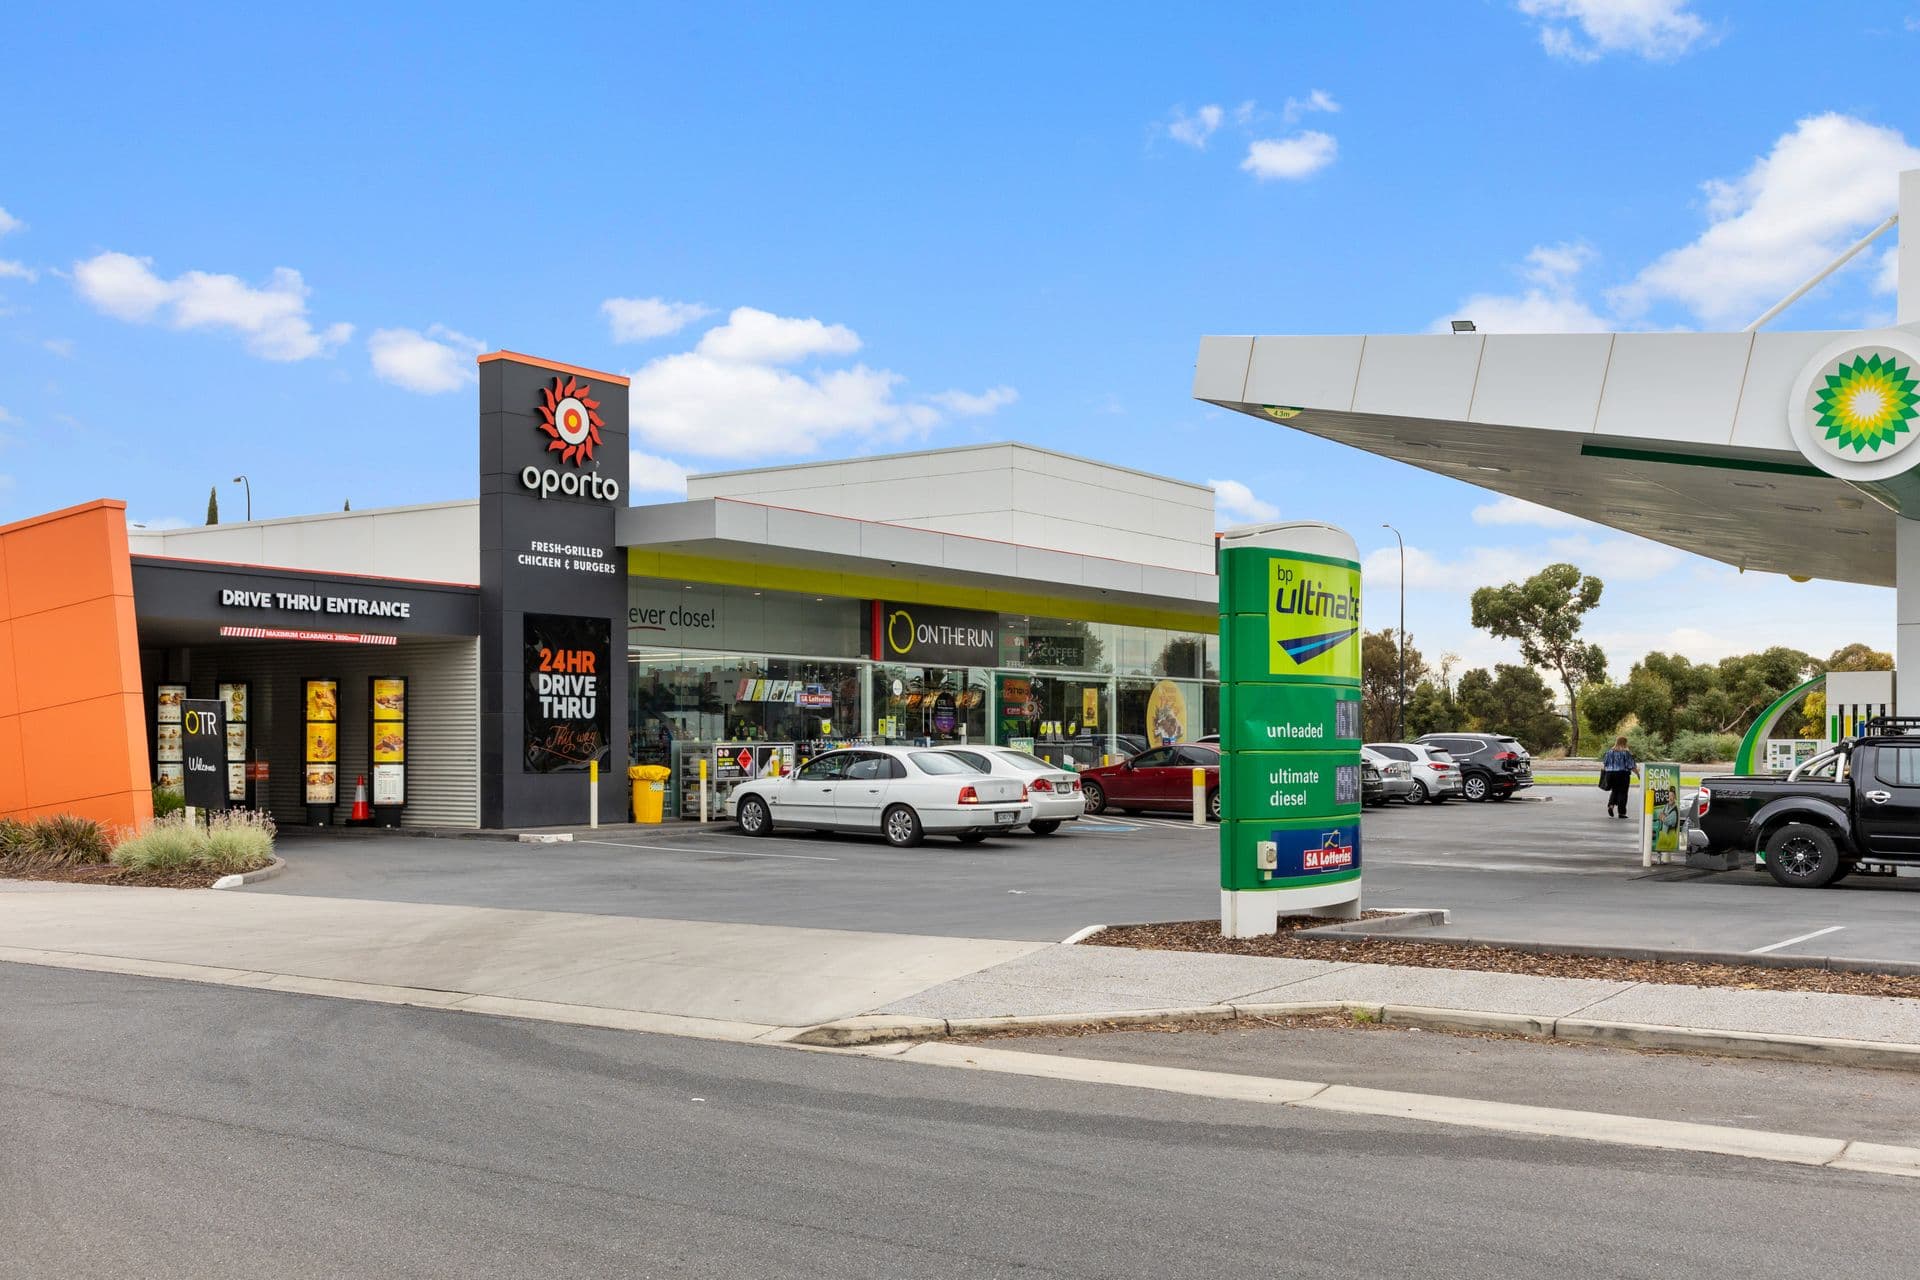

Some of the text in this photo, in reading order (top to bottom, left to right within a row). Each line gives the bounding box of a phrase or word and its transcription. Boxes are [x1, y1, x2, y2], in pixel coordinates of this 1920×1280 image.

[522, 465, 620, 501] oporto
[531, 541, 604, 558] FRESH-GRILLED
[518, 554, 616, 574] CHICKEN & BURGERS
[1277, 564, 1294, 585] bp
[222, 589, 410, 618] DRIVE THRU ENTRANCE
[1276, 579, 1360, 622] ultimate
[669, 605, 715, 629] close!
[265, 630, 299, 639] MAXIMUM
[299, 632, 333, 641] CLEARANCE
[917, 624, 993, 648] ON THE RUN
[540, 648, 595, 673] 24HR
[1039, 647, 1079, 658] COFFEE
[538, 673, 597, 696] DRIVE
[539, 696, 596, 719] THRU
[185, 710, 217, 735] OTR
[1266, 722, 1323, 738] unleaded
[188, 756, 216, 772] Welcome
[1648, 768, 1670, 779] SCAN
[1269, 768, 1319, 784] ultimate
[1649, 780, 1670, 791] PUMP
[1270, 790, 1307, 806] diesel
[1306, 850, 1351, 867] SA Lotteries
